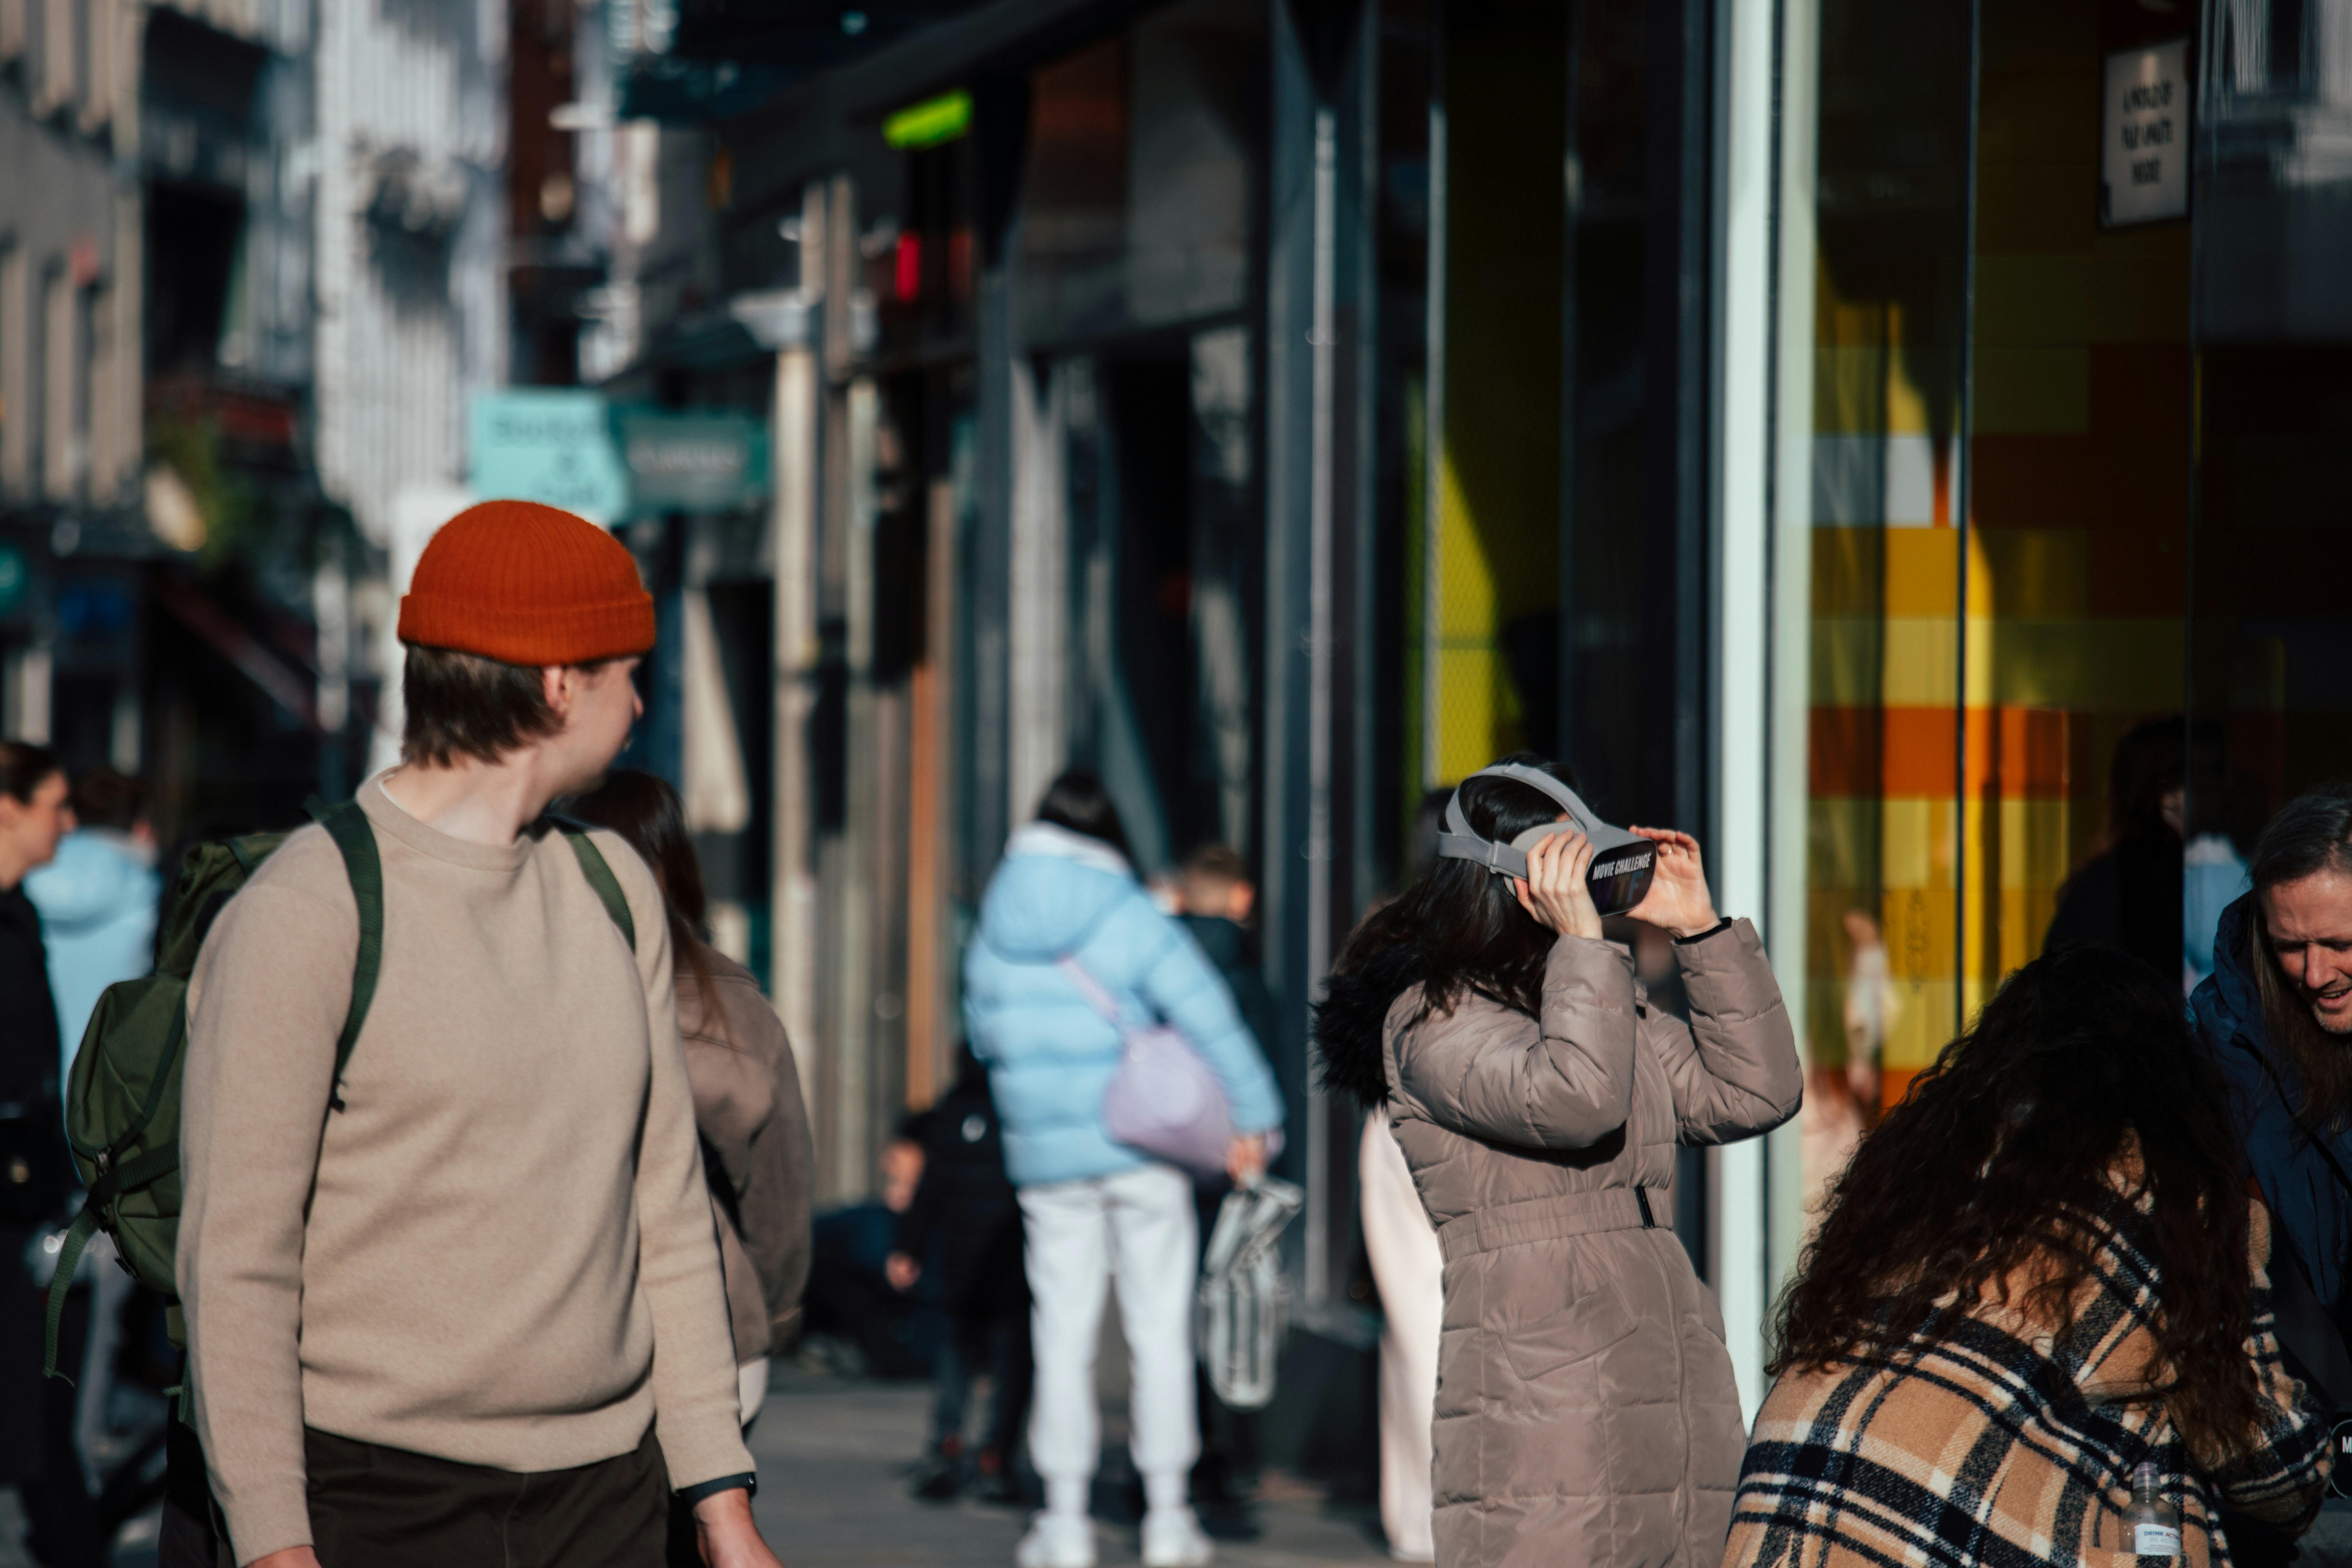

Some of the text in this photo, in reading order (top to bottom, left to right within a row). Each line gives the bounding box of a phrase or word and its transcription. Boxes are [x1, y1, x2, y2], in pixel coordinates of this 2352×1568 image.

[1592, 853, 1652, 880] MOVIE CHALLENGE
[1595, 870, 1644, 910] WTF
